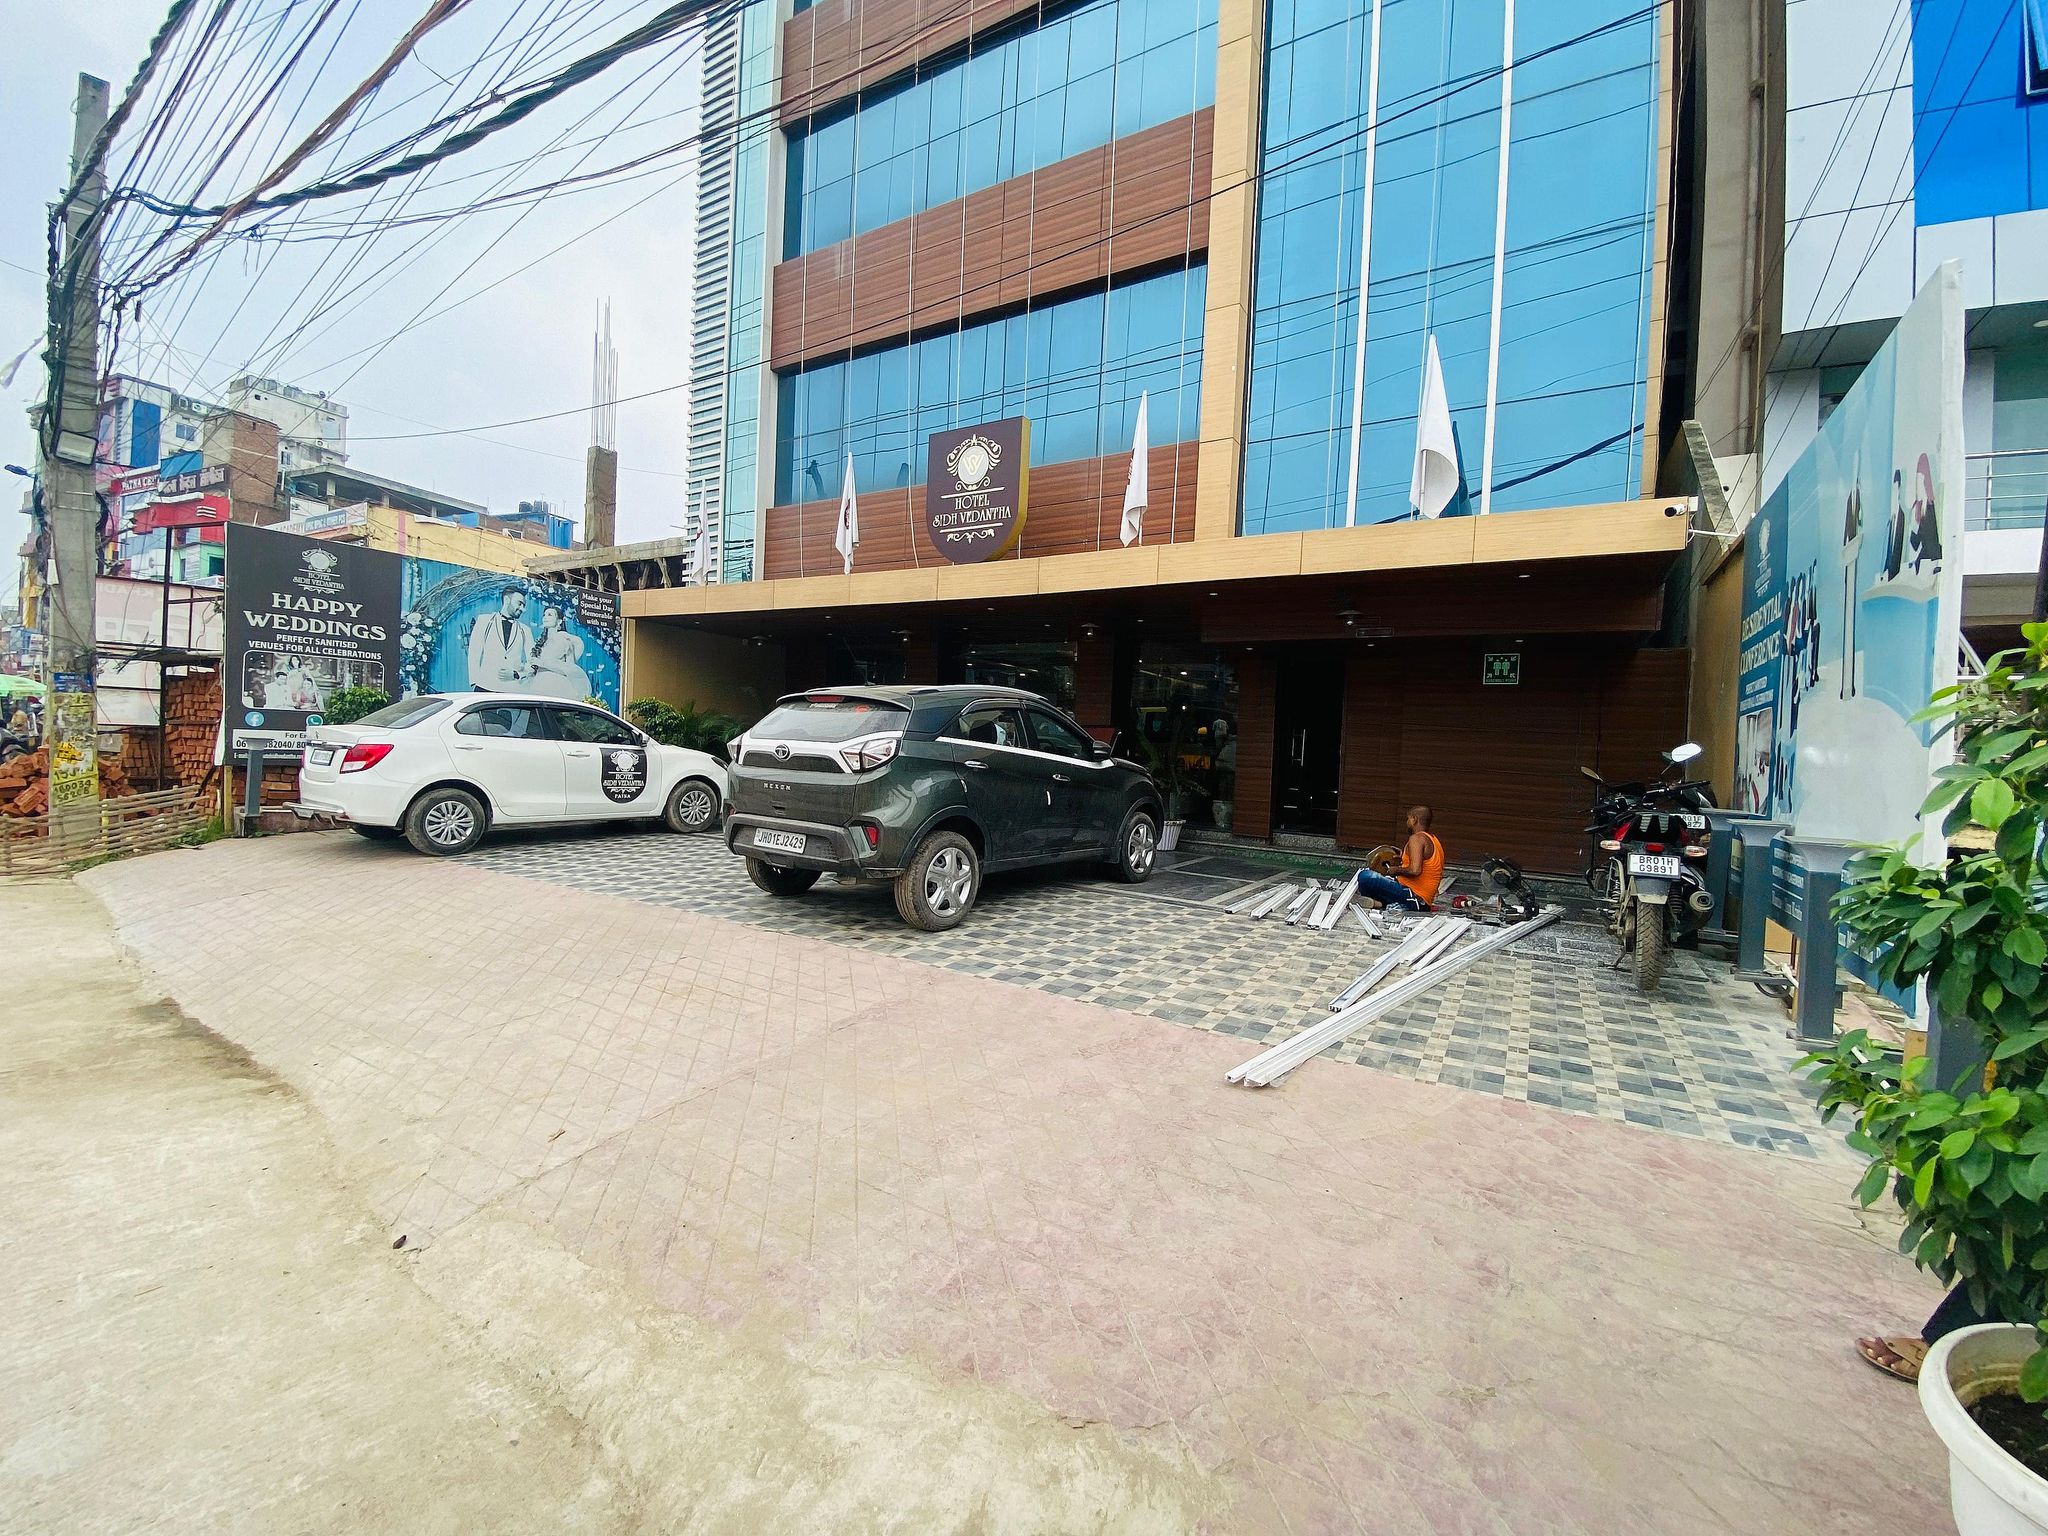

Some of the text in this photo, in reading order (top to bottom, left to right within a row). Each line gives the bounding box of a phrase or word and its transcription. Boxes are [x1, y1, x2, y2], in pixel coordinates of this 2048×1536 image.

[955, 494, 990, 510] HOTEL
[932, 506, 1011, 527] SIDH VEDANTHA
[308, 572, 331, 581] HOTEL
[272, 592, 363, 618] HAPPY
[582, 593, 598, 601] Make
[580, 600, 614, 613] Special Day
[581, 608, 613, 620] Memorable
[1741, 591, 1782, 643] RESIDENTIAL
[243, 610, 387, 641] WEDDINGS
[276, 634, 358, 649] PERFECT SANITISED
[249, 640, 382, 660] VENUES FOR ALL CELEBRATIONS
[1740, 629, 1780, 675] CONFERENCE
[758, 830, 804, 849] JH01EJ2429
[1639, 856, 1673, 866] BR01H
[1639, 864, 1673, 874] G9891
